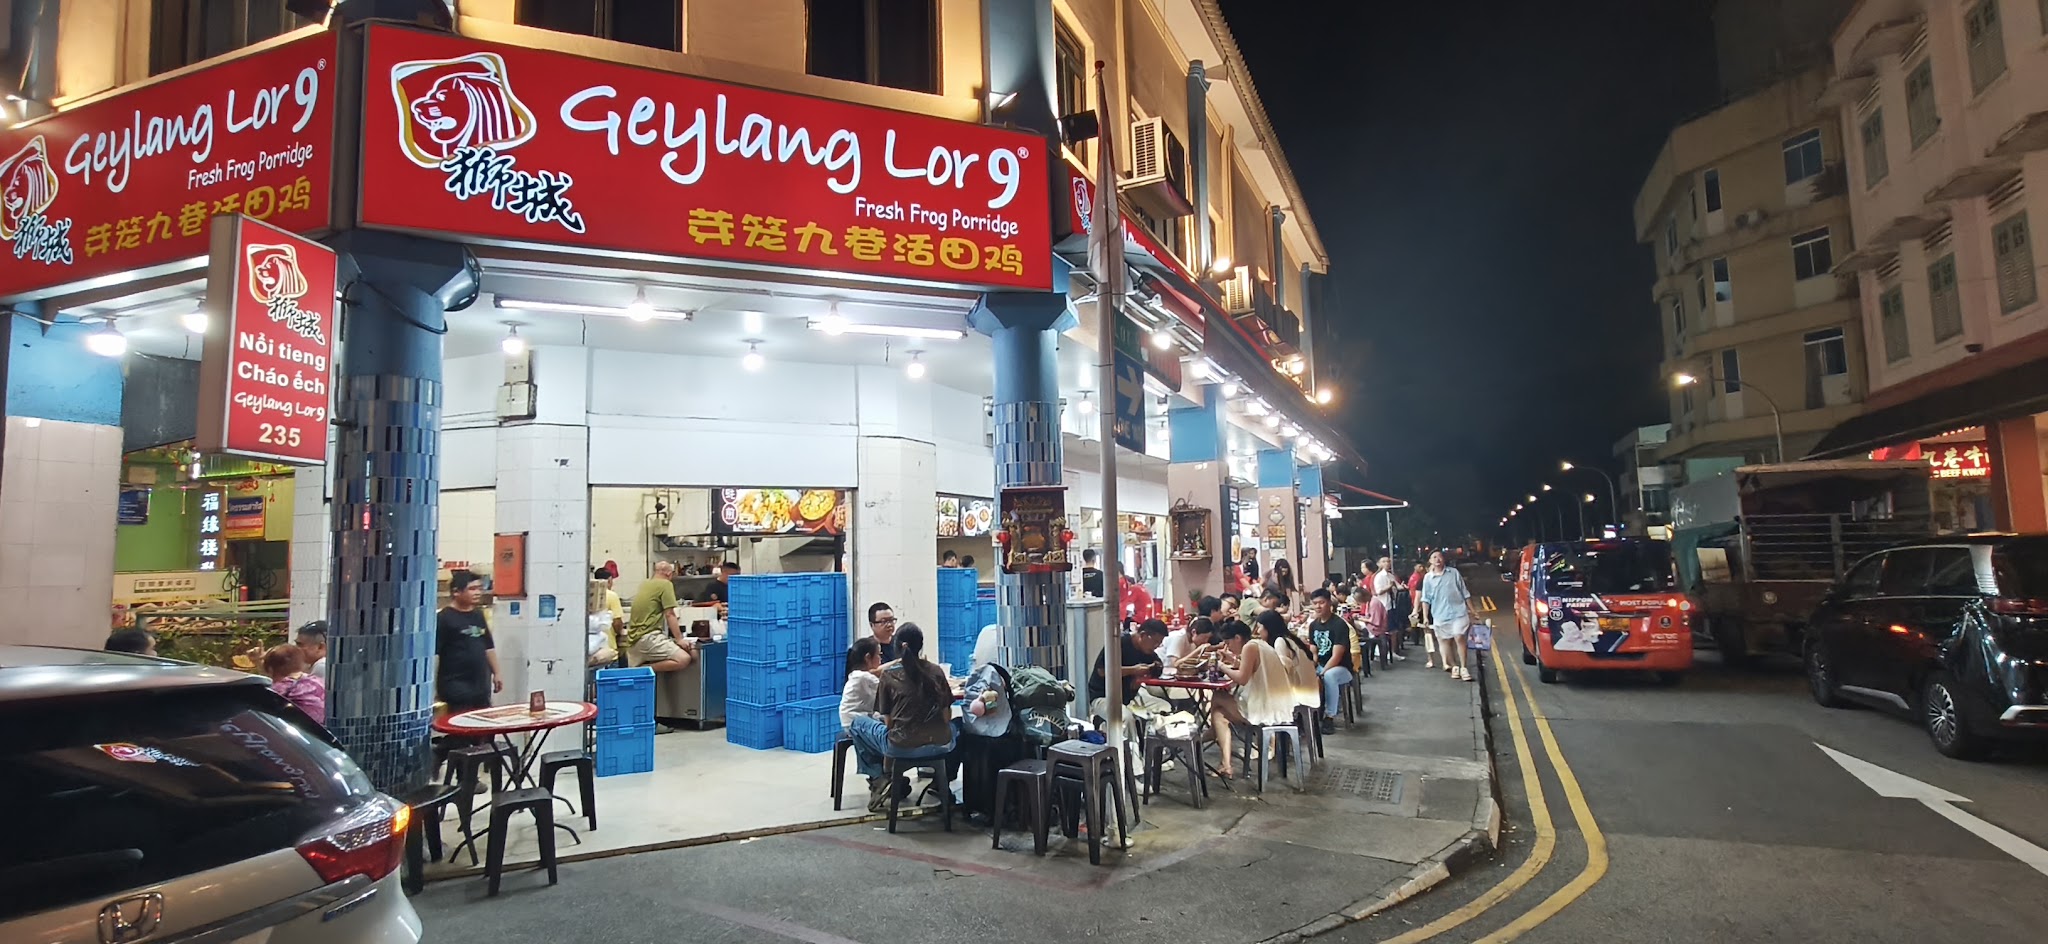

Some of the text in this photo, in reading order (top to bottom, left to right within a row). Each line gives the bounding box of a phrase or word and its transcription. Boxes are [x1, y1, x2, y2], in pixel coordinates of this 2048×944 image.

[64, 104, 214, 193] Geylang
[559, 84, 862, 194] Geylang
[187, 141, 313, 190] Fresh Frog Porridge
[855, 196, 1019, 240] Fresh Frog Porridge
[237, 361, 289, 387] Cháo
[234, 391, 292, 417] Geylang
[258, 423, 301, 448] 235
[1940, 468, 1961, 478] BEEF
[1962, 467, 1986, 477] KWAY
